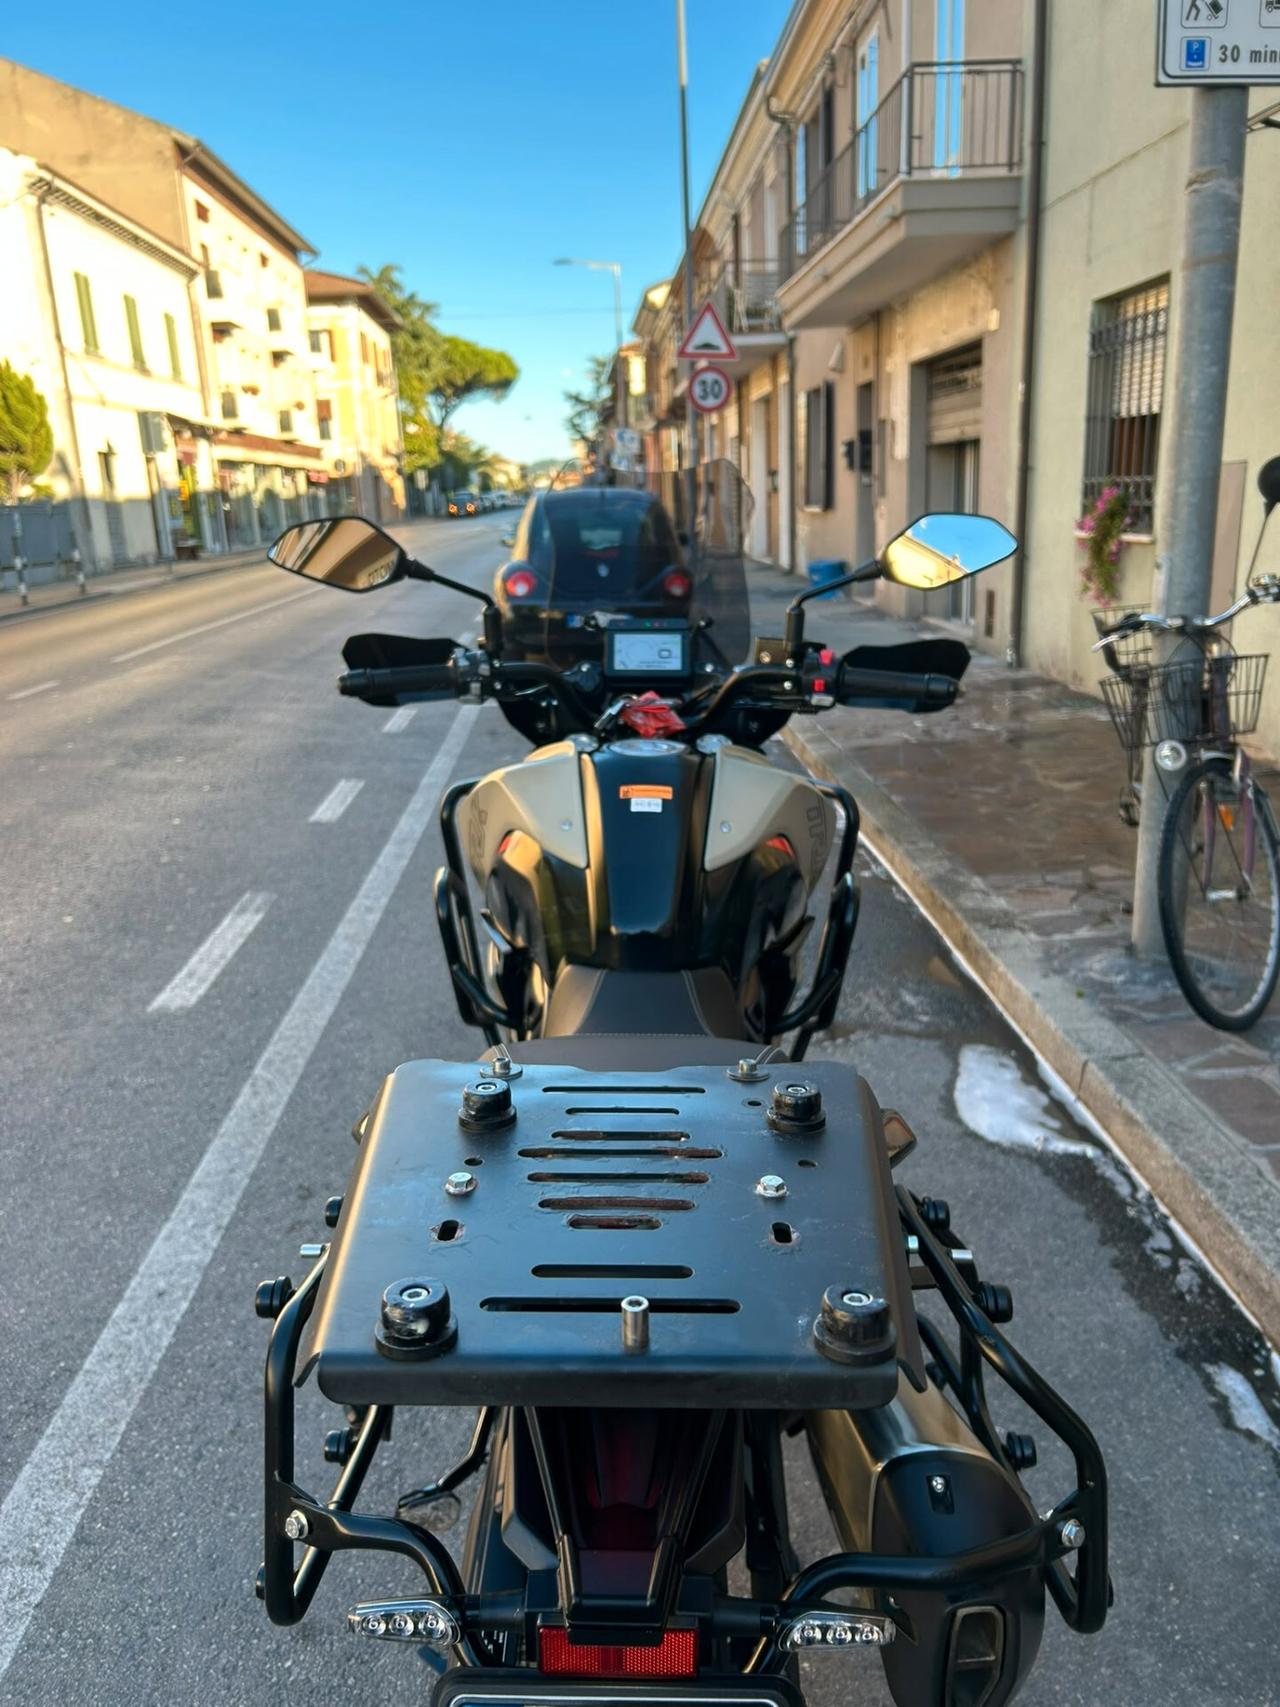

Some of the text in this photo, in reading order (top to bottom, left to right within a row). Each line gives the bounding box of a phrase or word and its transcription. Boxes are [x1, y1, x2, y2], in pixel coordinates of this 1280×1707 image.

[1219, 44, 1280, 63] 30 min
[699, 378, 723, 401] 30
